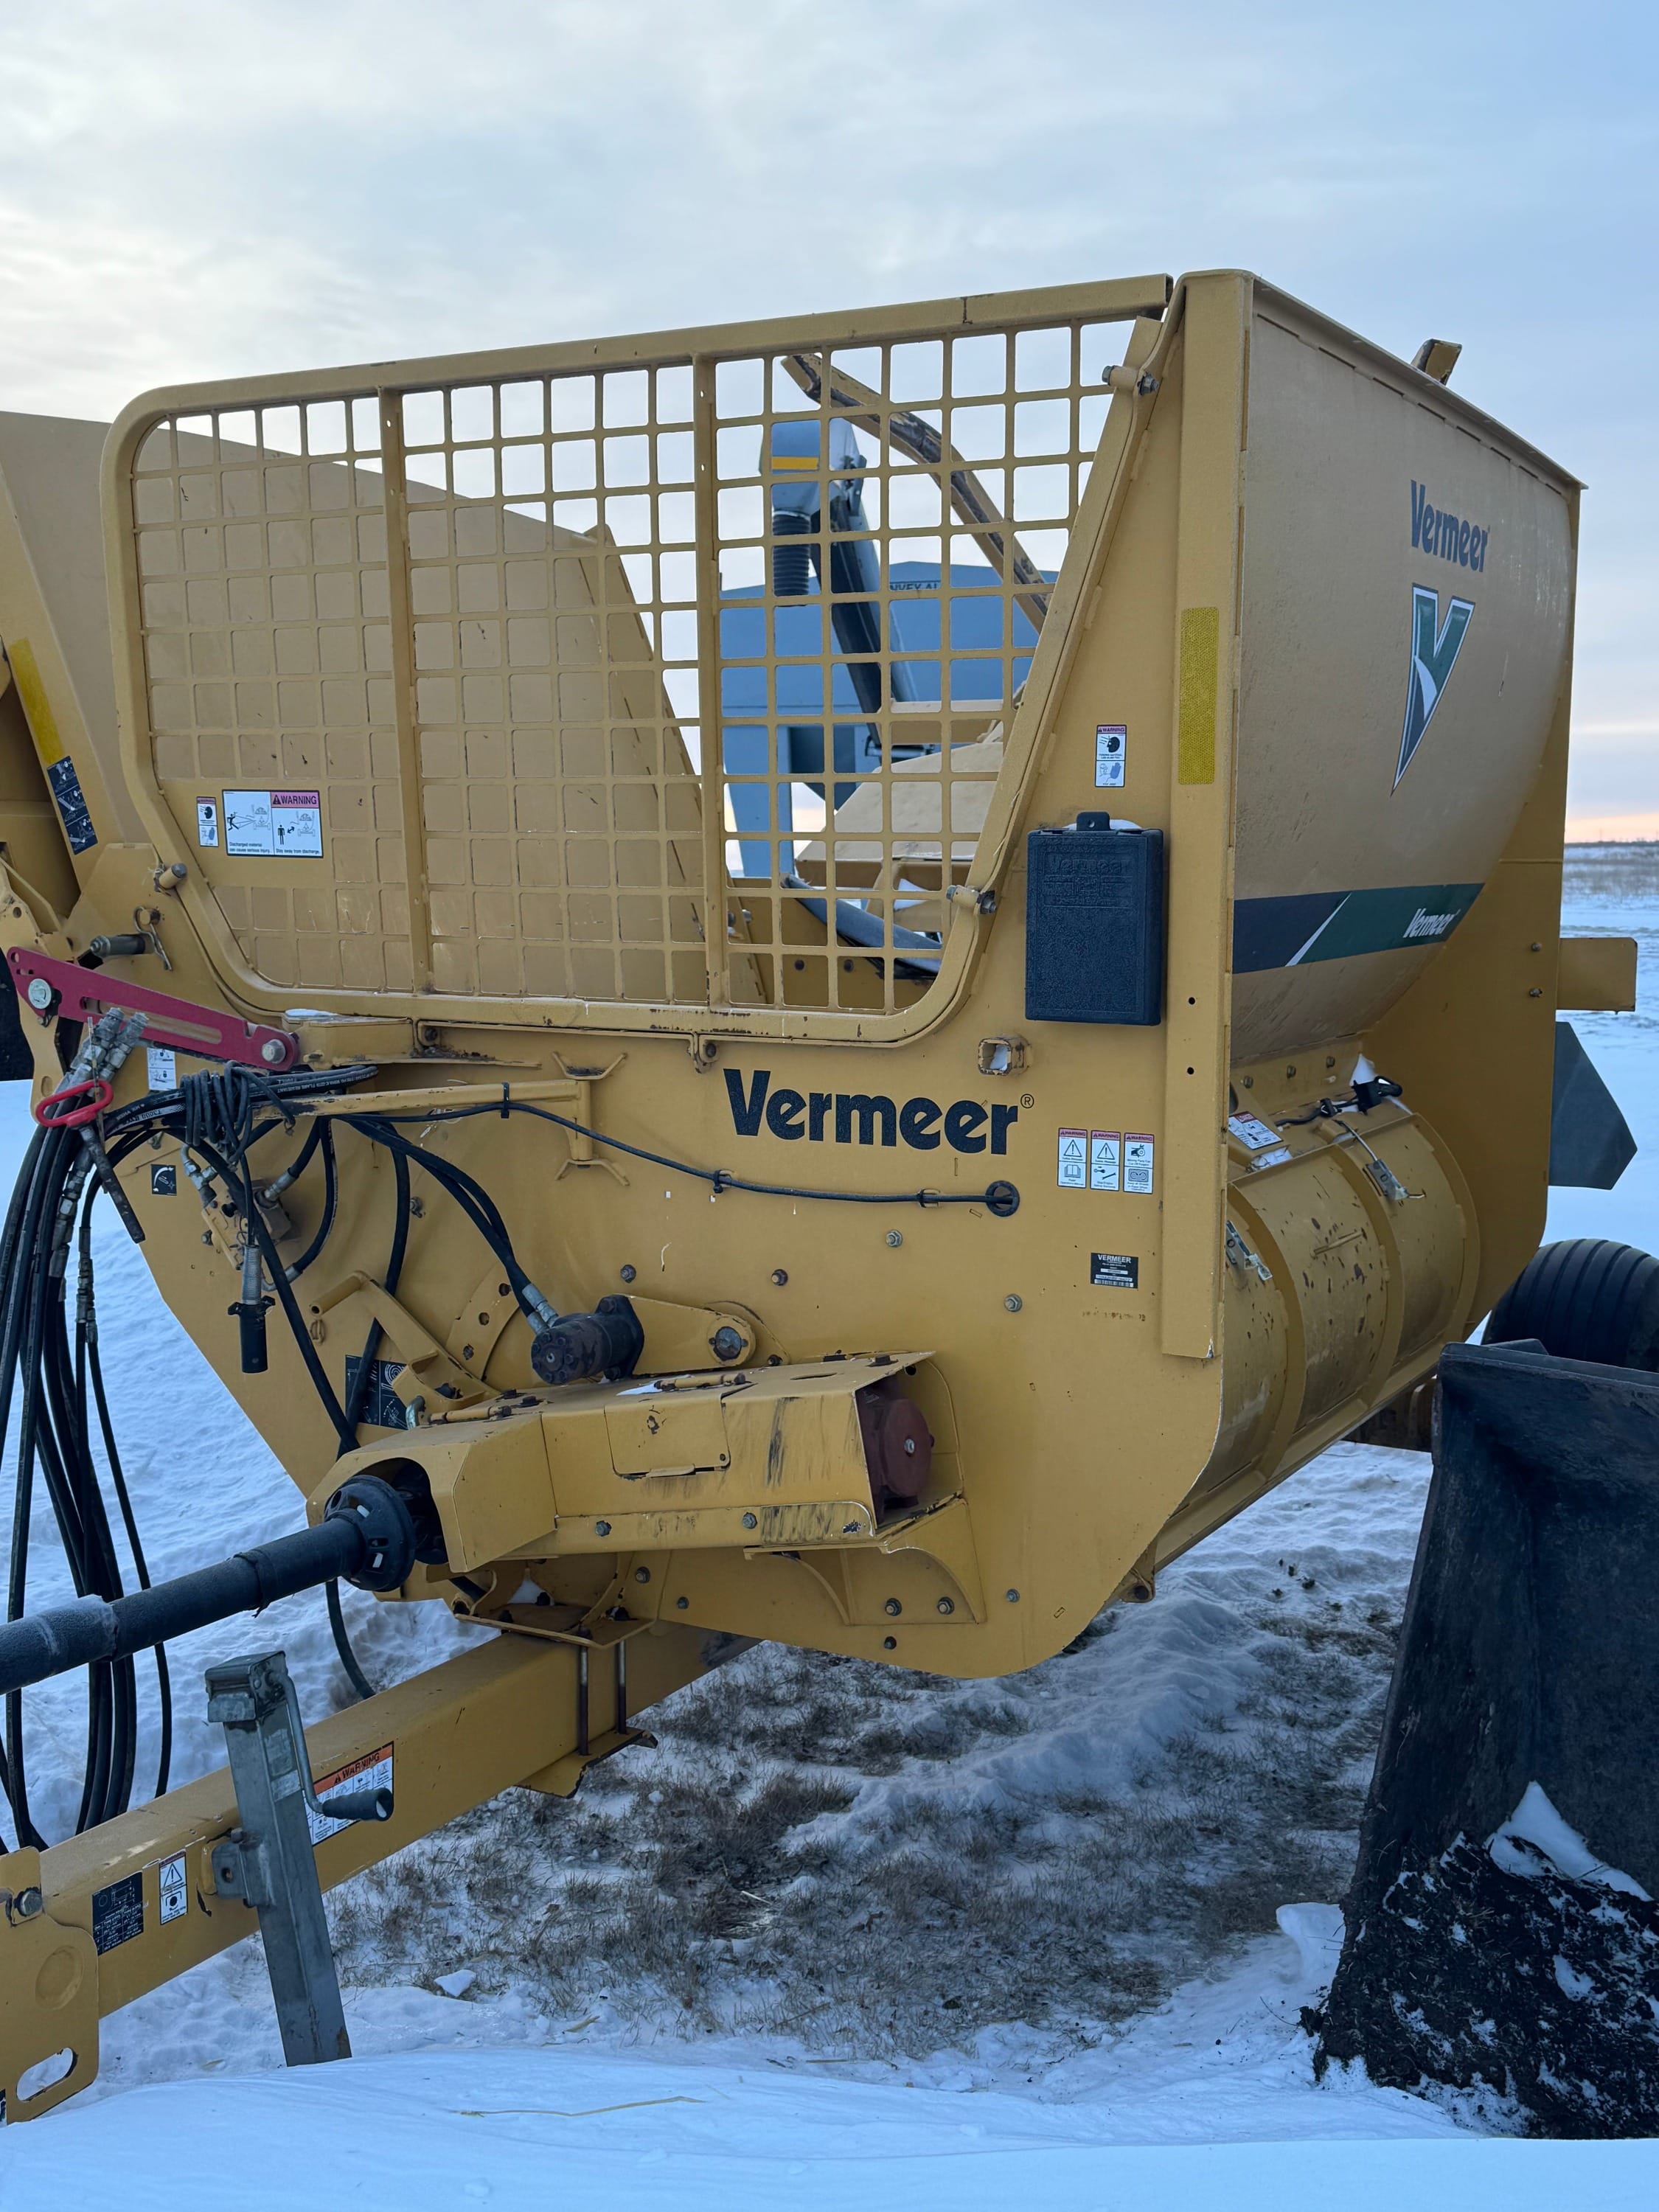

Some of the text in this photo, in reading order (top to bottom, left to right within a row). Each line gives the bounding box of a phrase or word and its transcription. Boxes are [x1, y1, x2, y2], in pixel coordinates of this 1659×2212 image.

[1411, 479, 1489, 573] Vermeer
[280, 796, 317, 804] WARNING
[1402, 908, 1455, 939] Vermeer
[1097, 1254, 1132, 1264] VERMEER
[342, 1753, 380, 1779] WARNING
